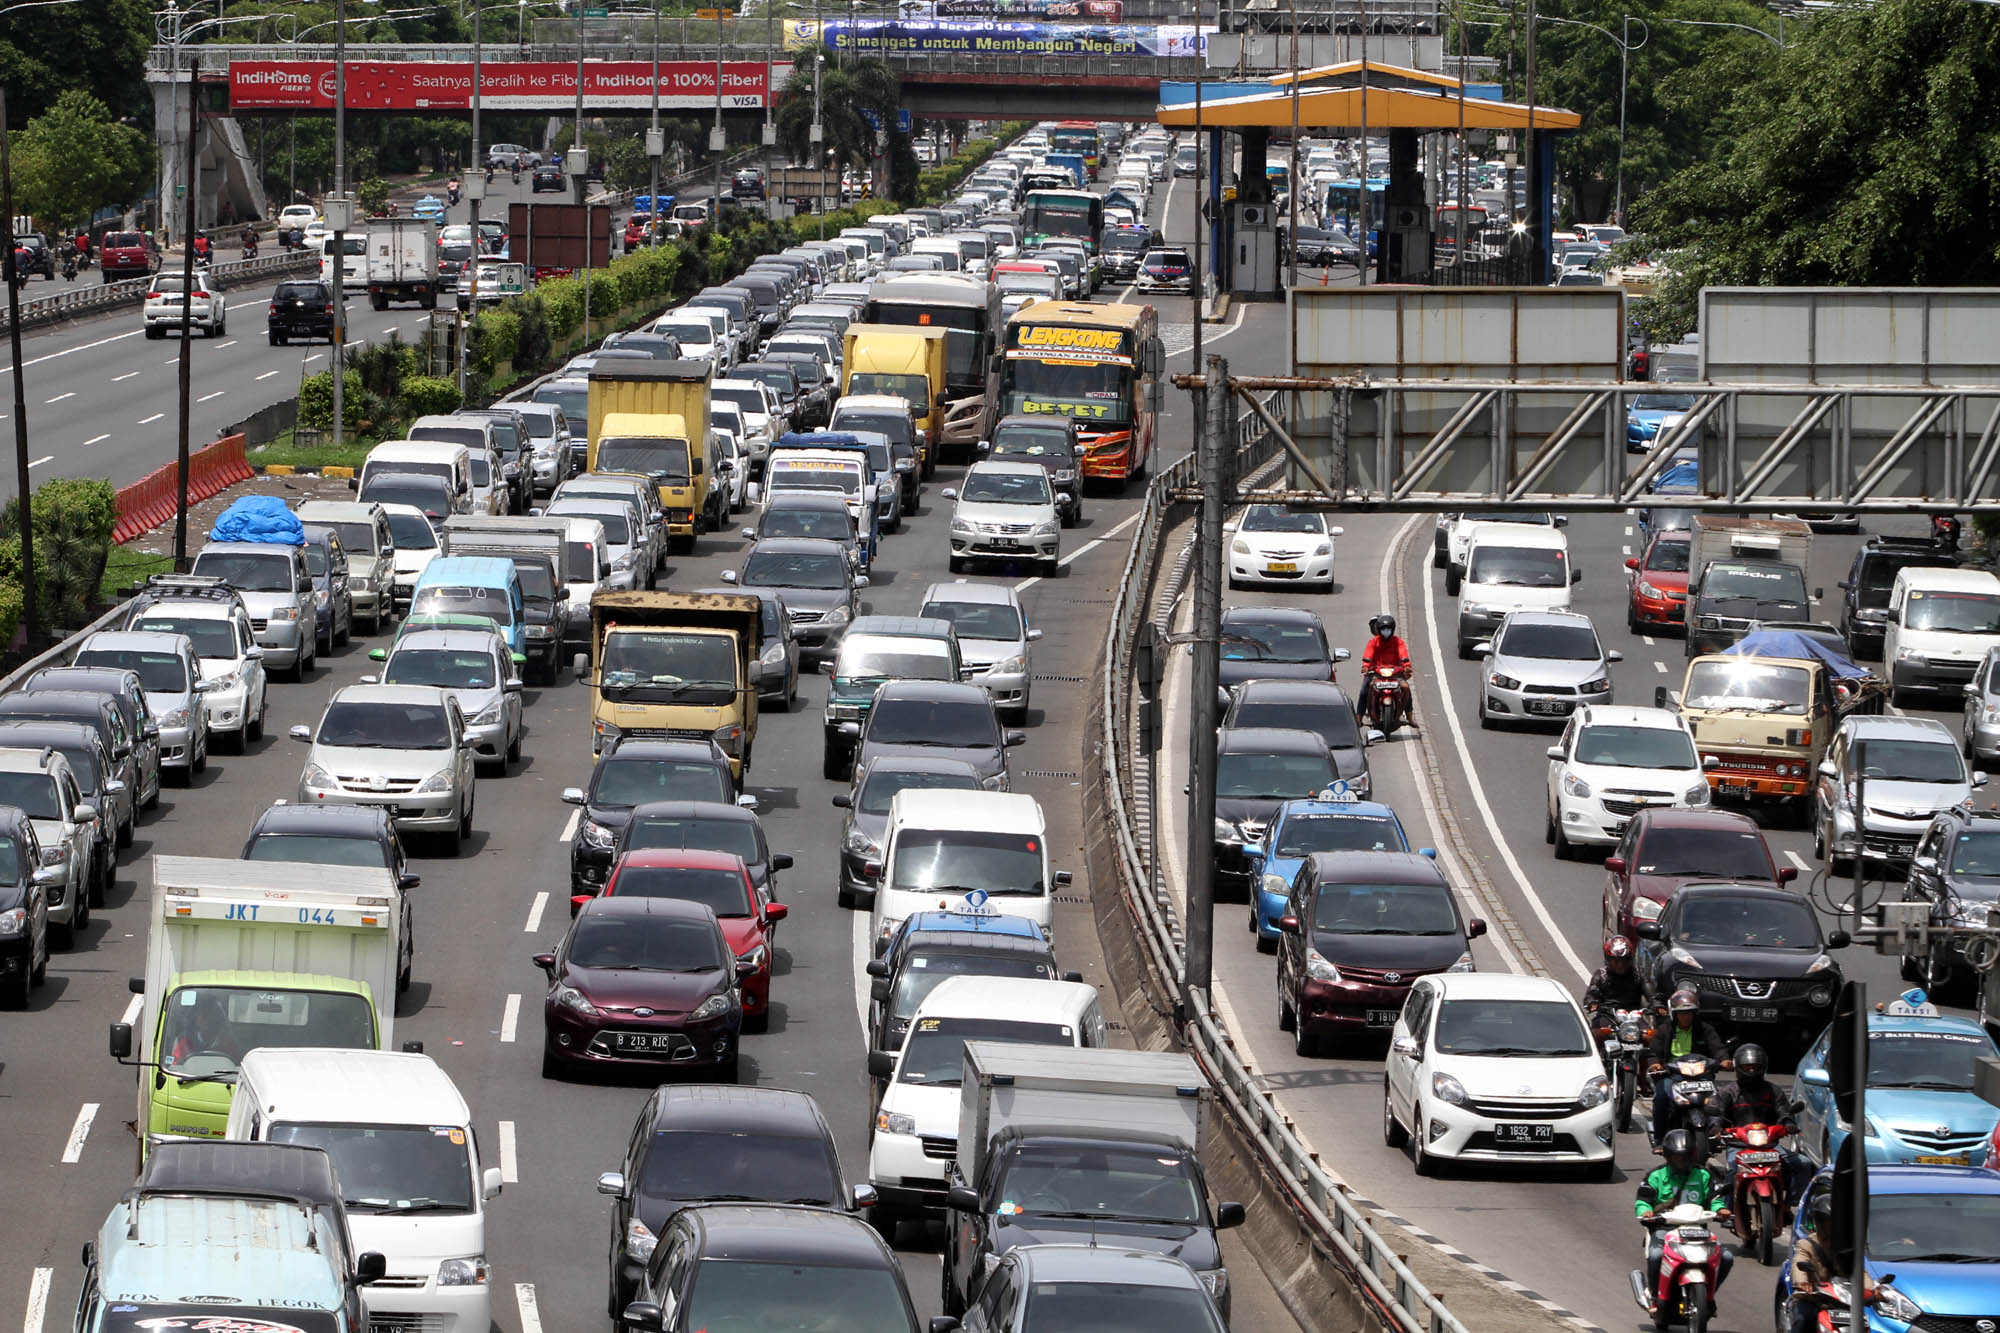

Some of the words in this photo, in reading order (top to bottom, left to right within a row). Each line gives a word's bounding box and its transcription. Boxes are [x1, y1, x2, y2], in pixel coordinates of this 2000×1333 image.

[922, 36, 969, 49] untuk
[975, 37, 1075, 53] Membangun
[1080, 39, 1136, 54] Negeri
[236, 70, 312, 84] IndiHome
[412, 75, 471, 89] Saatnya
[479, 74, 526, 87] Beralih
[530, 74, 547, 87] ke
[596, 74, 669, 87] IndiHome
[673, 73, 715, 87] 100%
[720, 74, 763, 87] Fiber!
[733, 97, 758, 105] VISA
[507, 275, 514, 284] 6
[1018, 326, 1122, 351] LENGKONG
[1073, 353, 1121, 362] JAKARTA
[1022, 400, 1109, 419] BETET
[1719, 762, 1768, 771] ITSUBISHI
[225, 903, 260, 921] JKT
[298, 906, 336, 925] 044
[960, 906, 991, 915] TAKSI
[1897, 1007, 1930, 1015] TAKSI
[618, 1035, 624, 1045] B
[630, 1036, 646, 1046] 213
[652, 1037, 668, 1048] RIC
[1914, 1032, 1942, 1040] BIRD
[1942, 1034, 1982, 1044] GROUP
[1496, 1125, 1503, 1136] B
[1509, 1125, 1529, 1136] 1832
[1535, 1126, 1552, 1137] PRY
[119, 1292, 160, 1303] POS
[256, 1298, 326, 1310] LEGOK
